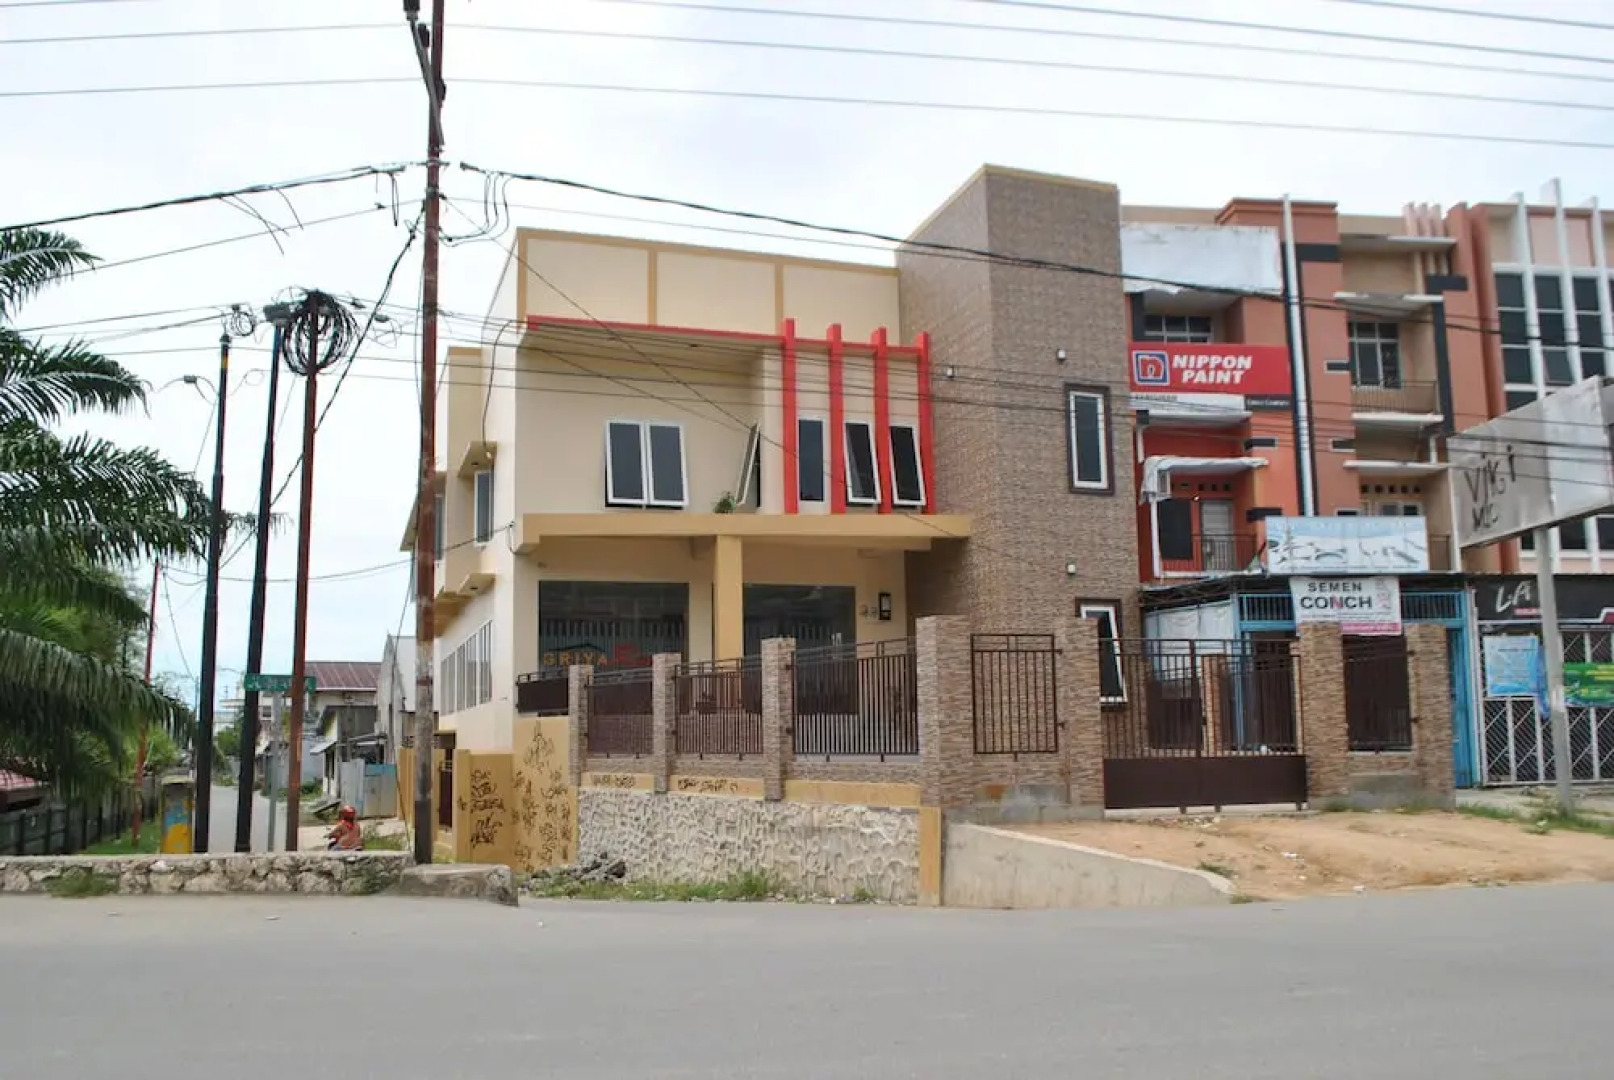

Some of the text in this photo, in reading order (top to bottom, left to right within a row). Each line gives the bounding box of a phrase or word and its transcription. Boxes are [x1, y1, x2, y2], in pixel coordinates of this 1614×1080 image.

[1172, 354, 1252, 369] NIPPON
[1181, 370, 1245, 384] PAINT
[1308, 582, 1362, 592] SEMEN
[1300, 595, 1373, 610] CONCH
